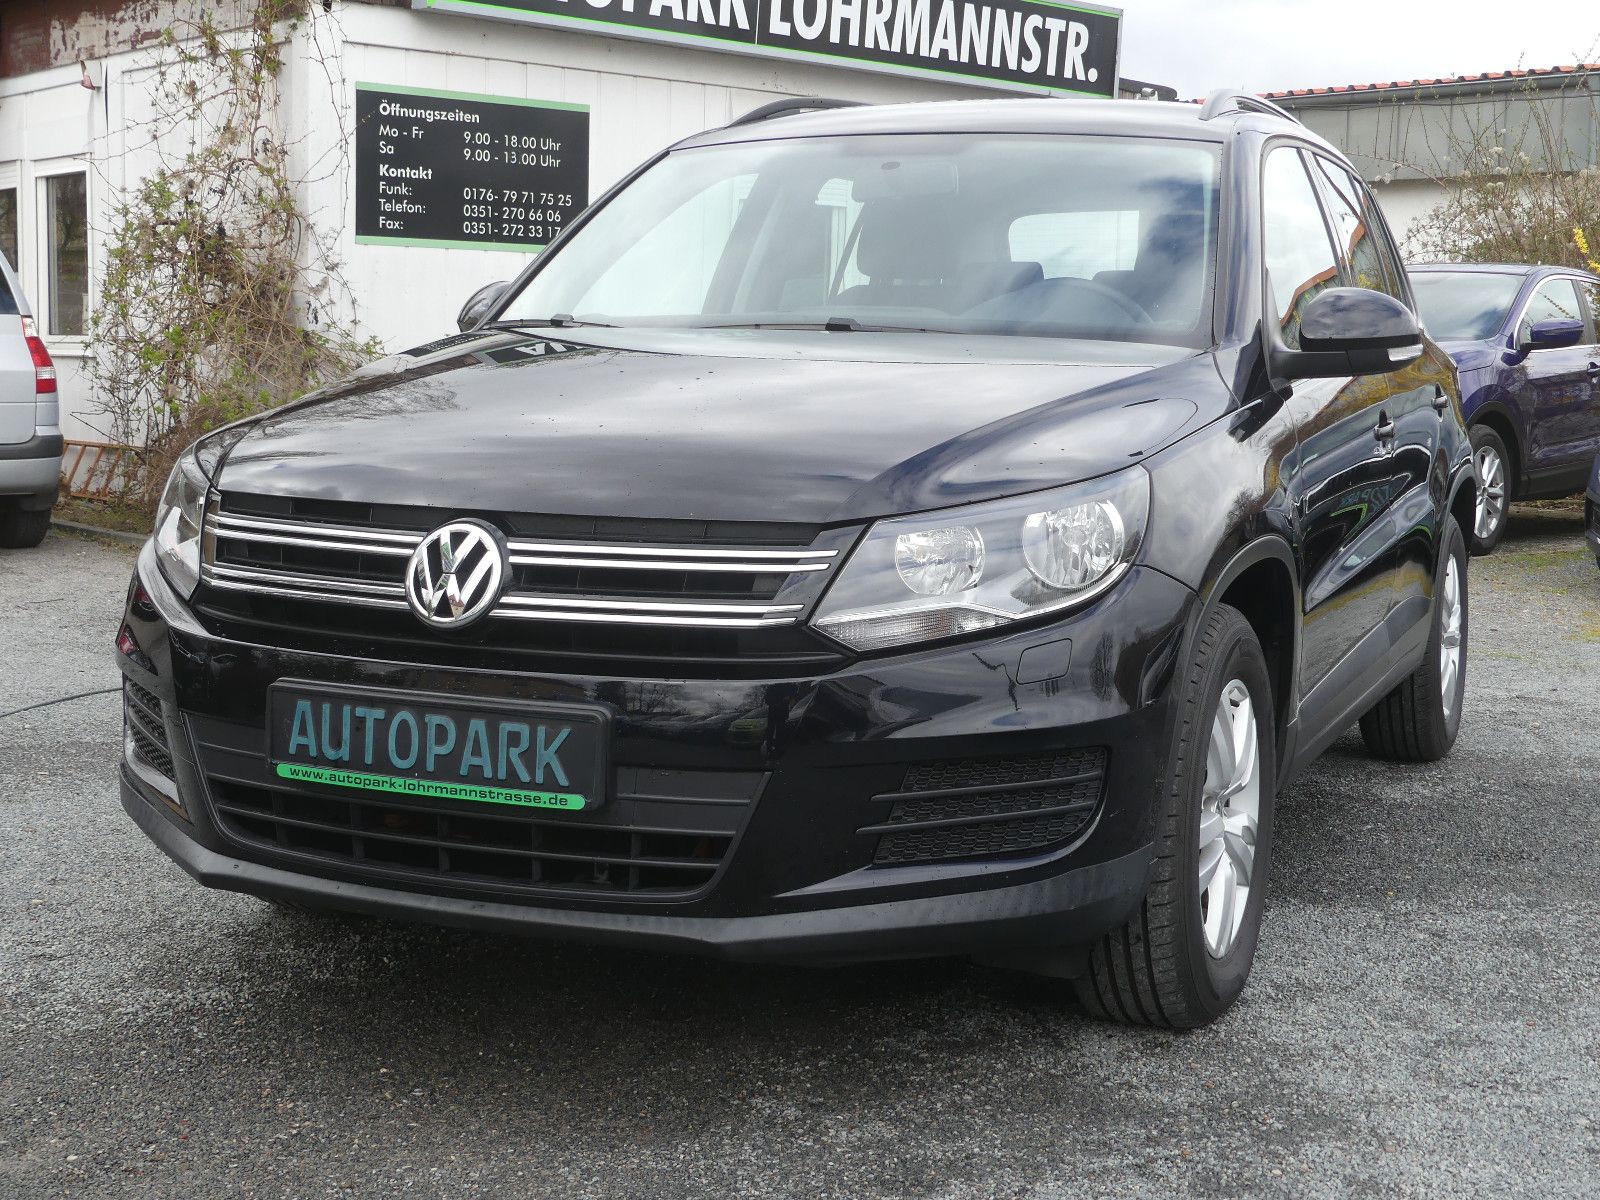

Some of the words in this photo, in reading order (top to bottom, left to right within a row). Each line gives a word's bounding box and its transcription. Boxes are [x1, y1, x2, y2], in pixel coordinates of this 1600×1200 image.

[768, 0, 1098, 83] LOHRMANNSTR.
[379, 99, 480, 123] Öffnungszeiten
[379, 124, 399, 137] Mo
[412, 126, 424, 139] Fr
[463, 131, 491, 145] 9.00
[504, 134, 537, 149] 18.00
[540, 137, 561, 151] Uhr
[379, 141, 394, 154] Sa
[463, 148, 491, 162] 9.00
[504, 151, 537, 166] 13.00
[540, 154, 561, 168] Uhr
[379, 163, 433, 179] Kontakt
[379, 181, 412, 196] Funk:
[463, 187, 499, 201] 0176-
[503, 190, 518, 203] 79
[521, 191, 534, 204] 71
[540, 192, 554, 205] 75
[558, 194, 572, 207] 25
[378, 198, 426, 214] Telefon:
[463, 204, 499, 218] 0351-
[502, 207, 525, 220] 270
[528, 208, 543, 221] 66
[547, 210, 561, 222] 06
[379, 216, 404, 230] Fax:
[463, 221, 499, 235] 0351-
[502, 224, 524, 237] 272
[528, 225, 543, 238] 33
[547, 226, 561, 239] 17
[288, 698, 571, 787] AUTOPARK
[289, 766, 569, 807] www.autopark-lohrmannstrasse.de
